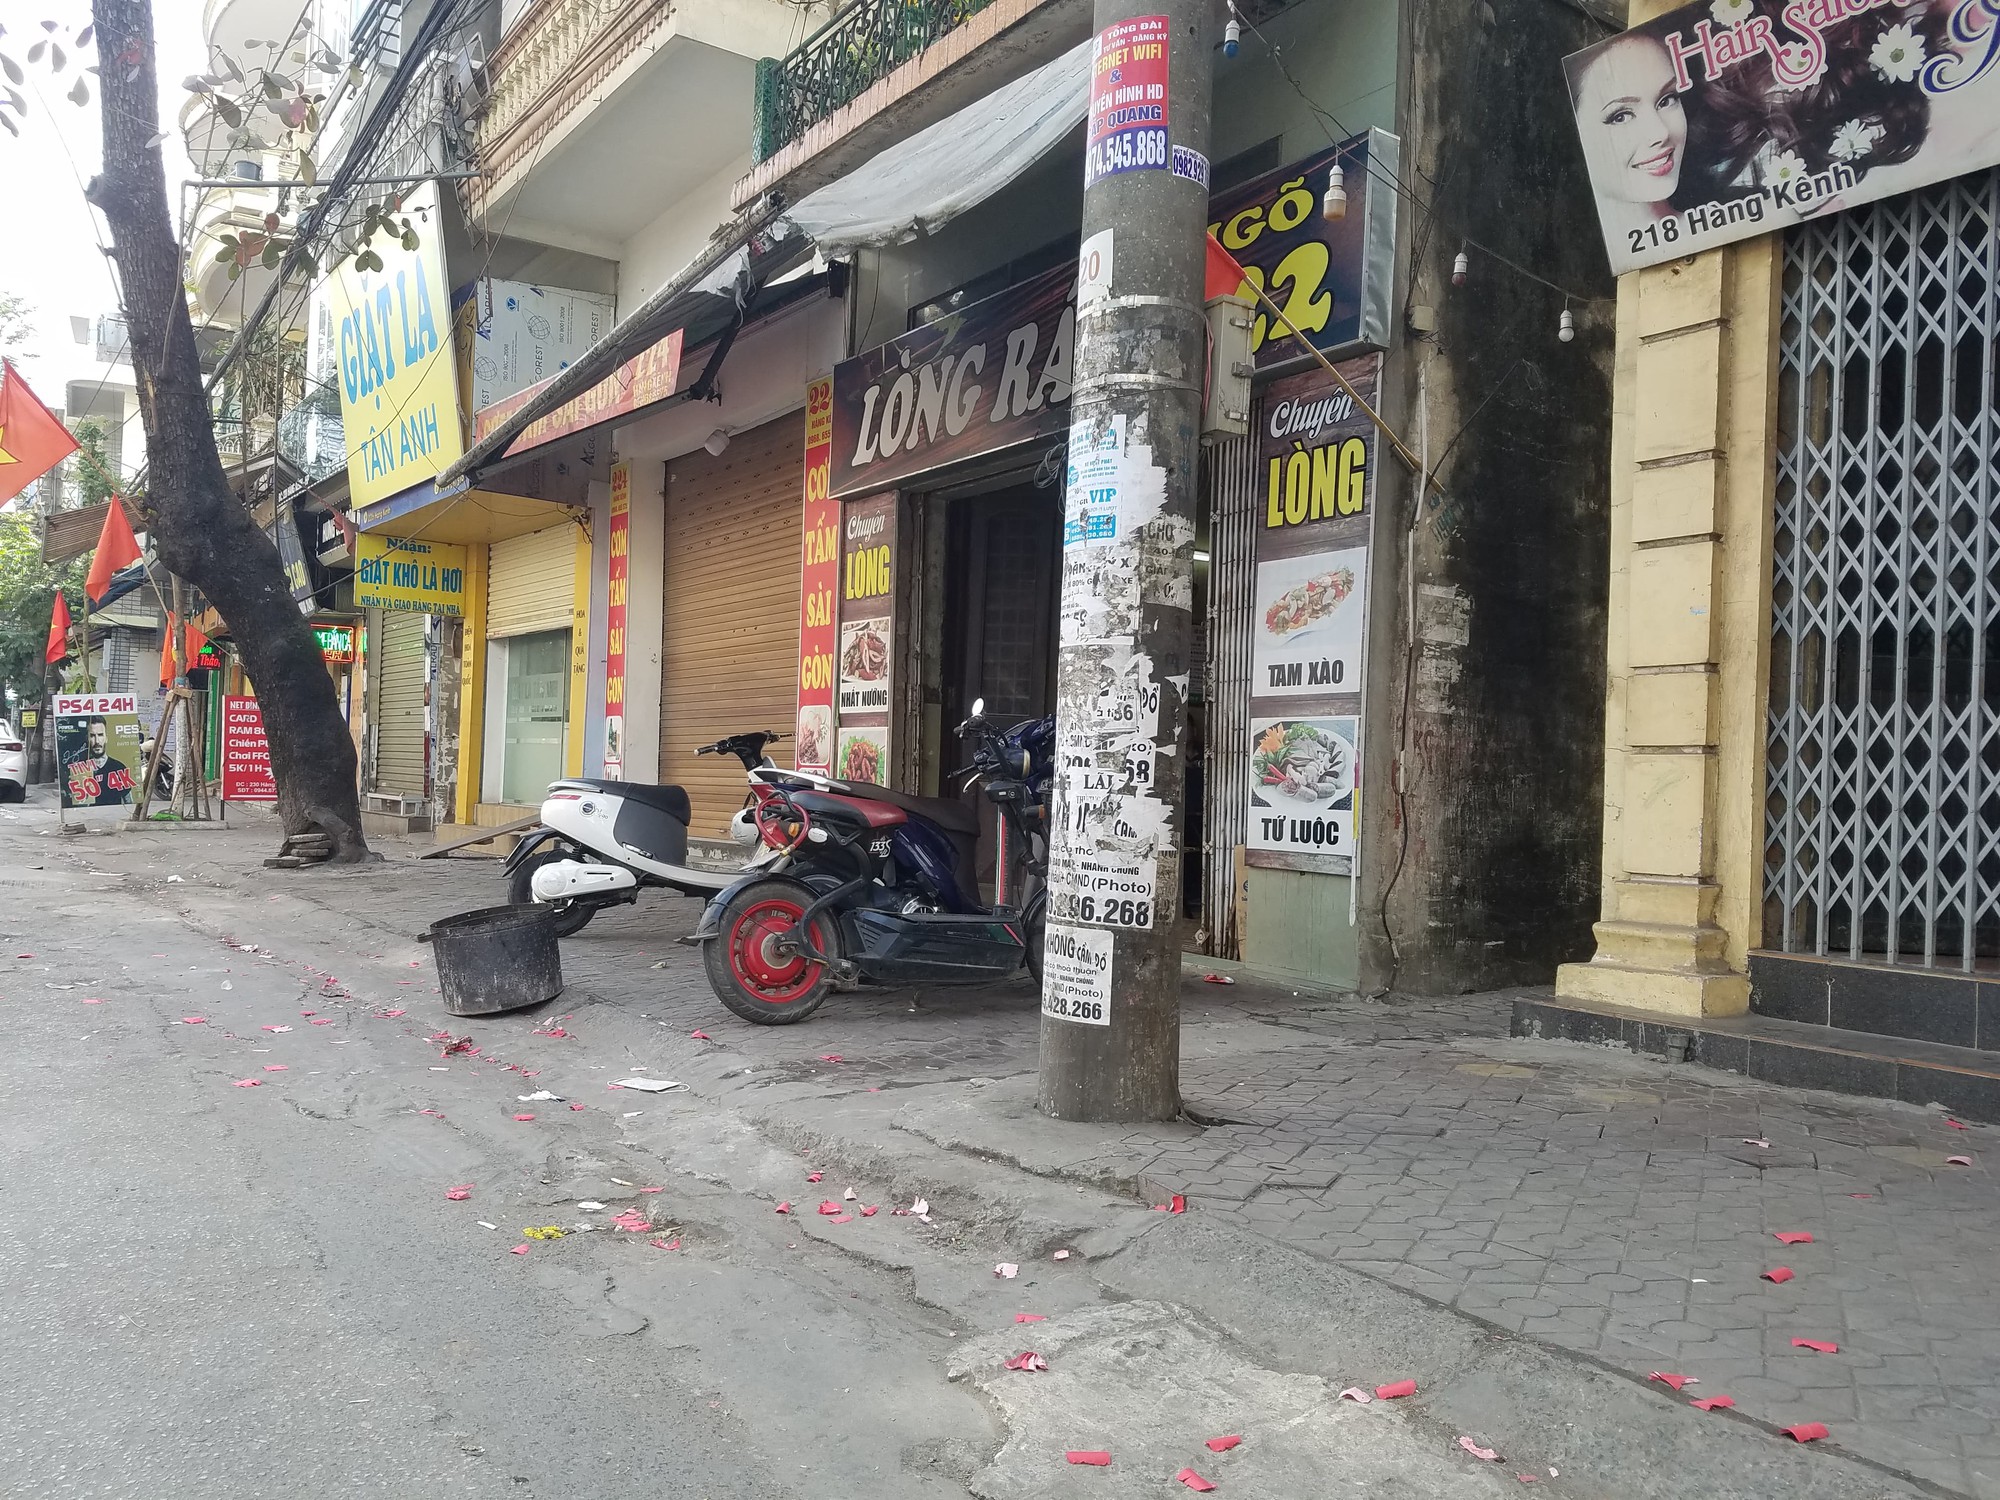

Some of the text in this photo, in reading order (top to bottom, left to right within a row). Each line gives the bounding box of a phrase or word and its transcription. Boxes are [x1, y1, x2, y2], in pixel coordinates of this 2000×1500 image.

[1133, 43, 1162, 61] WIFI
[1110, 68, 1122, 84] &
[1115, 84, 1143, 105] HÌNH
[1147, 84, 1163, 100] HD
[1107, 104, 1162, 129] QUANG
[1628, 163, 1855, 254] 218 Hàng Kênh
[1270, 387, 1353, 439] Chuyên
[361, 425, 395, 483] TÂN
[401, 403, 440, 467] ANH
[807, 457, 831, 503] CƠ
[1267, 438, 1365, 528] LÒNG
[1089, 487, 1117, 504] VIP
[610, 524, 627, 559] CƠM
[806, 512, 838, 566] TẤM
[361, 554, 462, 593] GIẶT KHÔ LÀ HƠI
[846, 543, 890, 600] LÒNG
[360, 594, 381, 608] NHẬN
[382, 595, 393, 608] VÀ
[394, 599, 411, 610] GIAO
[412, 599, 432, 612] HÀNG
[446, 603, 461, 615] NHÀ
[576, 610, 586, 618] HOA
[806, 581, 832, 628] SÀI
[609, 620, 623, 656] SÀI
[801, 645, 833, 690] GÒN
[1268, 657, 1344, 687] TAM XÀO
[607, 669, 623, 705] GÒN
[58, 698, 134, 713] PS4 24H
[230, 699, 260, 709] NET BÌN
[115, 724, 139, 735] PES
[229, 714, 258, 723] CARD
[229, 726, 252, 734] RAM
[108, 768, 137, 791] 4K
[1261, 815, 1339, 849] TỨ LUỘC
[1092, 878, 1151, 897] (Photo)
[1065, 985, 1104, 1000] (Photo)
